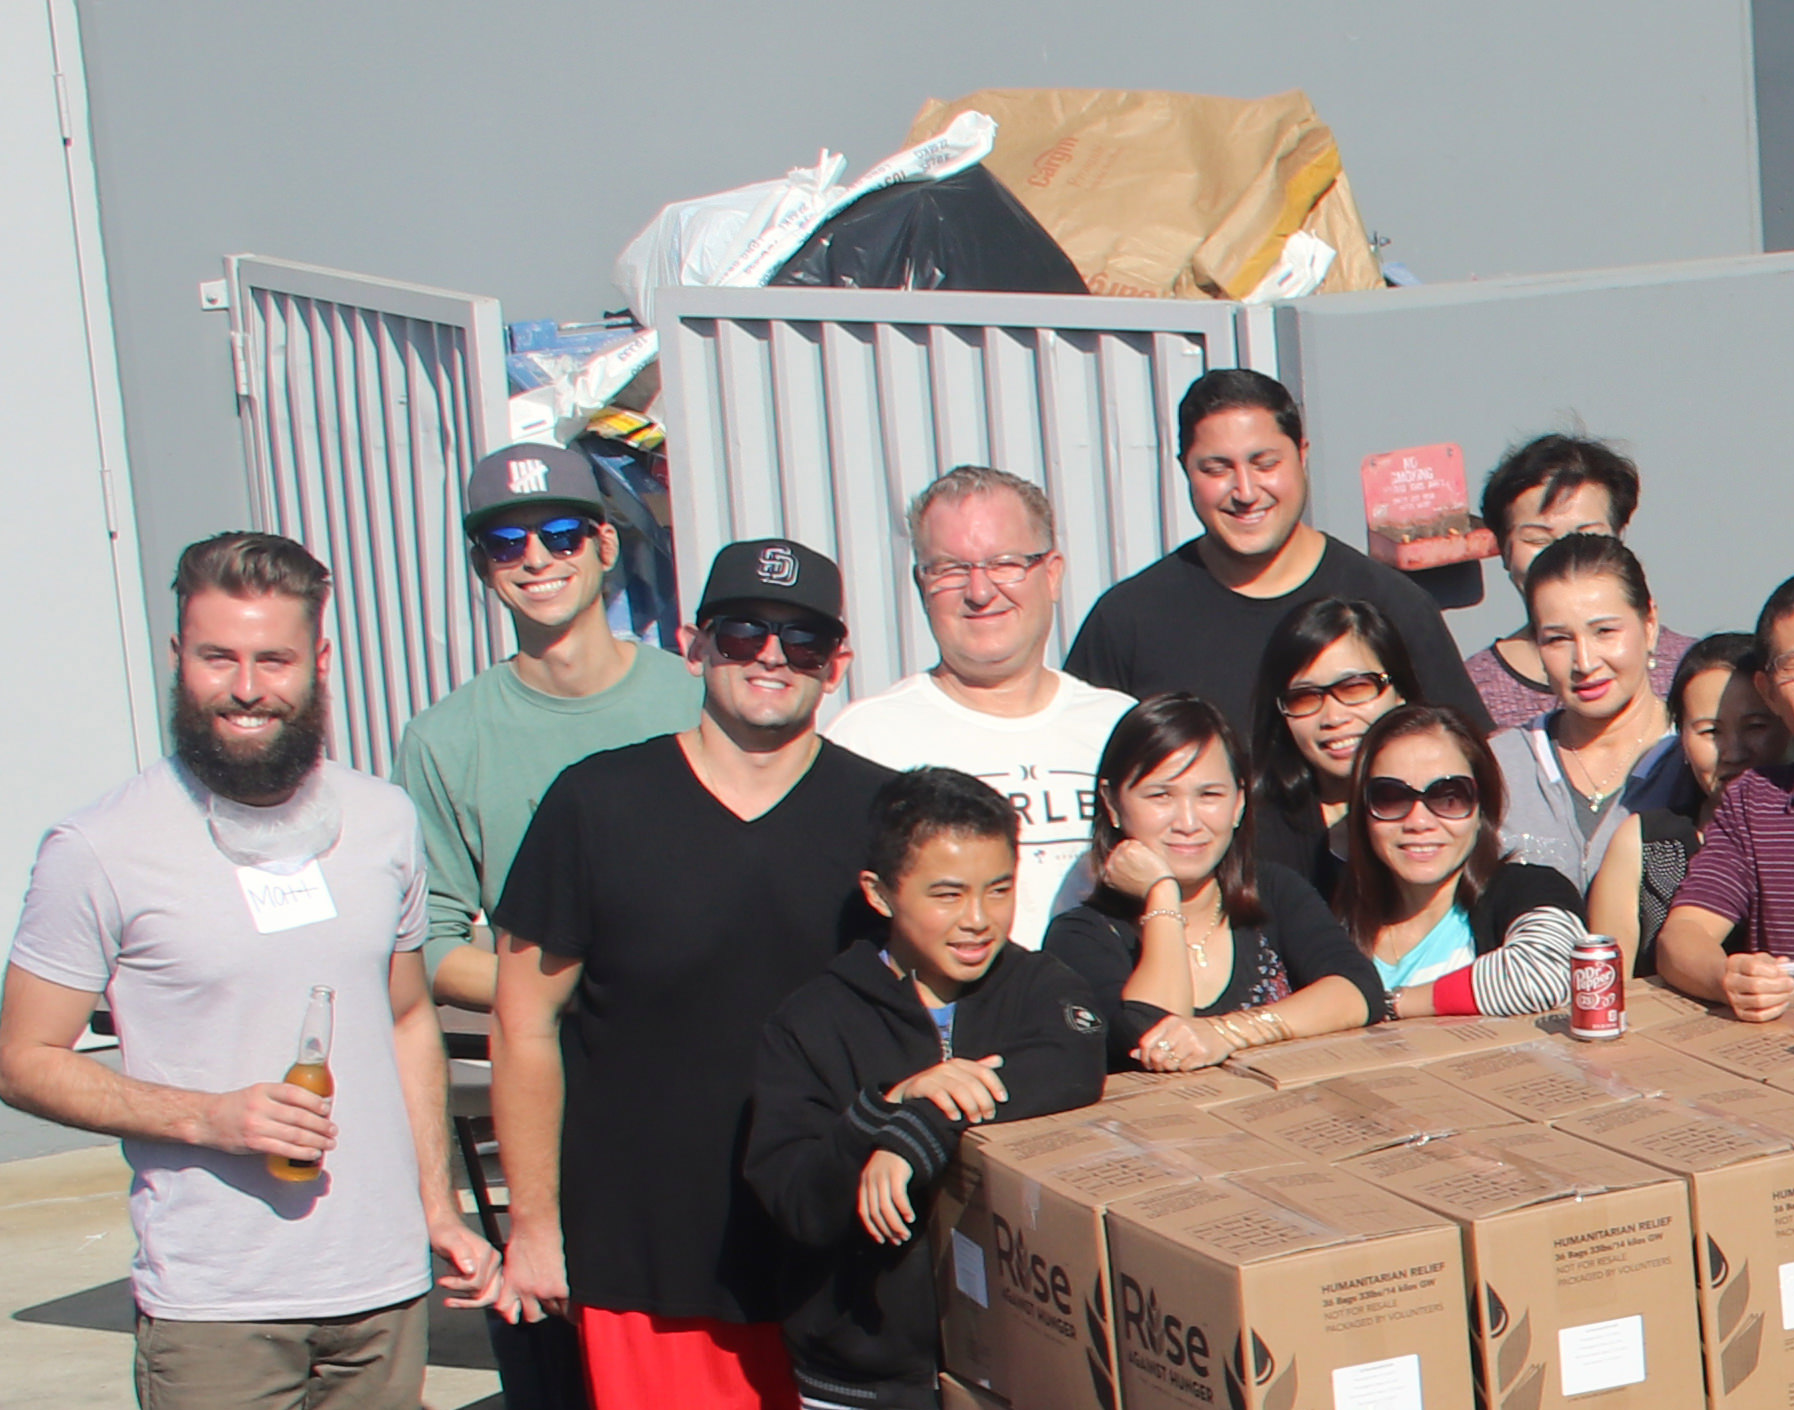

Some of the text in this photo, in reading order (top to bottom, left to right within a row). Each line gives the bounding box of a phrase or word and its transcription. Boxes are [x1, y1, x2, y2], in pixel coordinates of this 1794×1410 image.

[248, 880, 319, 912] Matt
[998, 1213, 1073, 1316] Rise
[1120, 1272, 1210, 1378] Rise
[1128, 1351, 1215, 1404] AGAINST HUNGER
